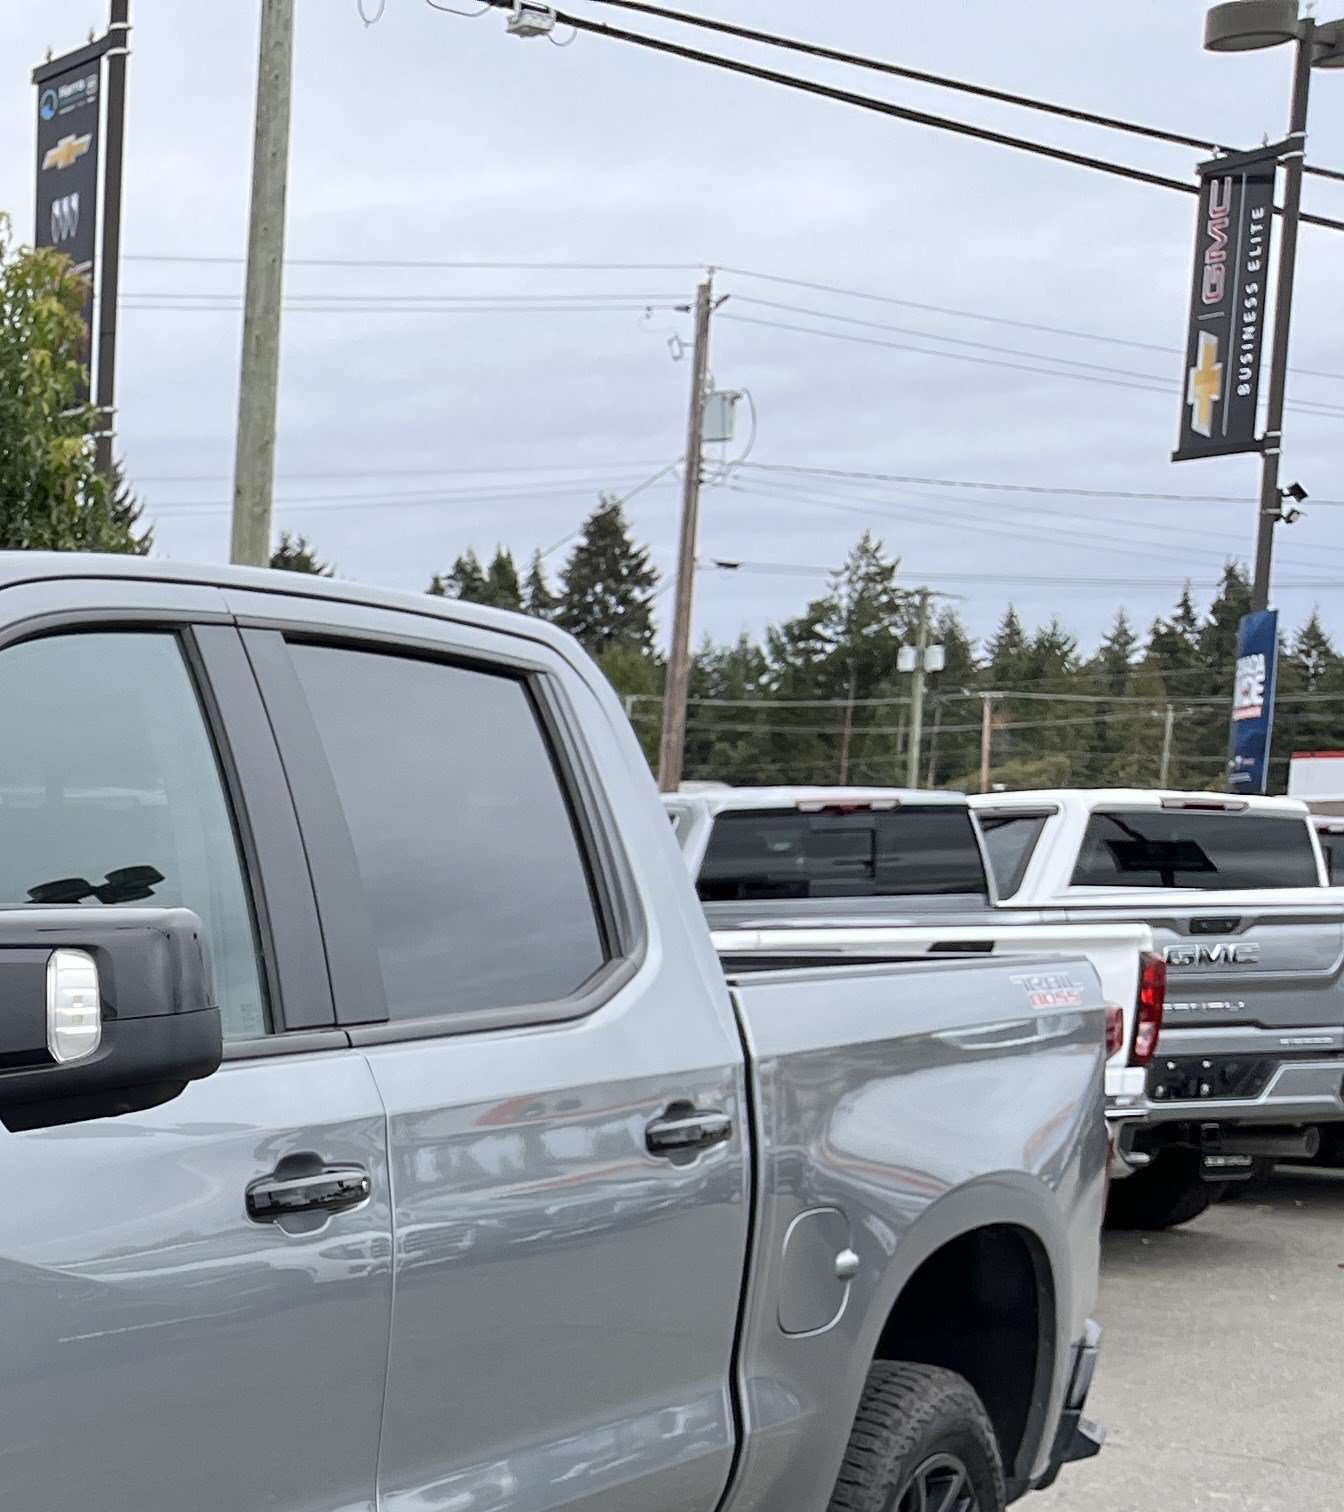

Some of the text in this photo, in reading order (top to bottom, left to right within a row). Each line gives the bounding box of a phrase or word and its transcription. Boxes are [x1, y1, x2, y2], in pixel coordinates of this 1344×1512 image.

[1202, 176, 1233, 305] GMC
[1237, 206, 1265, 397] BUSINESS ELITE
[1163, 943, 1260, 967] GMC
